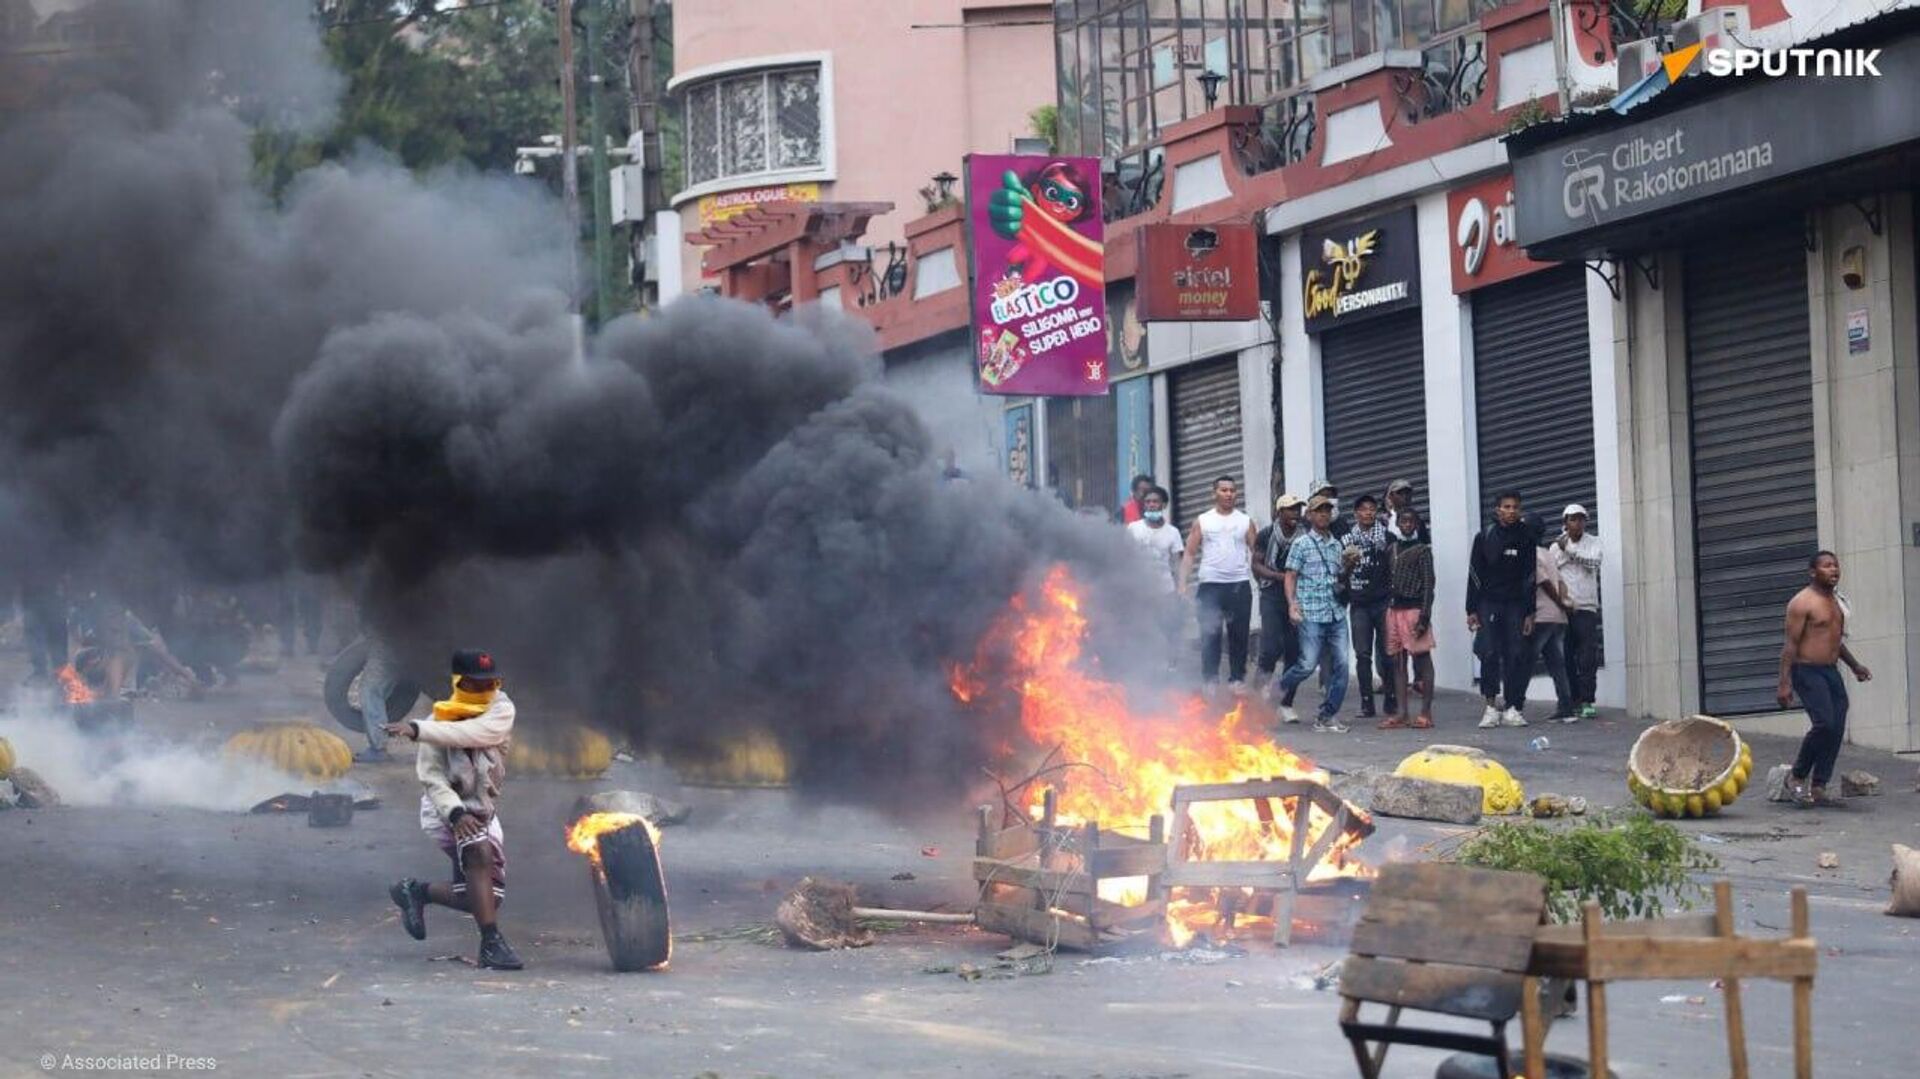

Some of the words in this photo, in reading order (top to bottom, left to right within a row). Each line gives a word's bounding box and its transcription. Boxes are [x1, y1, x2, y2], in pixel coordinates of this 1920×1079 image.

[1612, 129, 1685, 172] Gilbert
[1613, 141, 1773, 207] Rakotomanana
[1493, 190, 1515, 247] ai
[991, 276, 1079, 324] ELASTICO
[1178, 290, 1228, 308] money
[1337, 281, 1409, 316] PERSONALITY
[1021, 307, 1079, 338] SILIGOMA
[1029, 329, 1070, 354] SUPER
[1069, 317, 1101, 340] HERO
